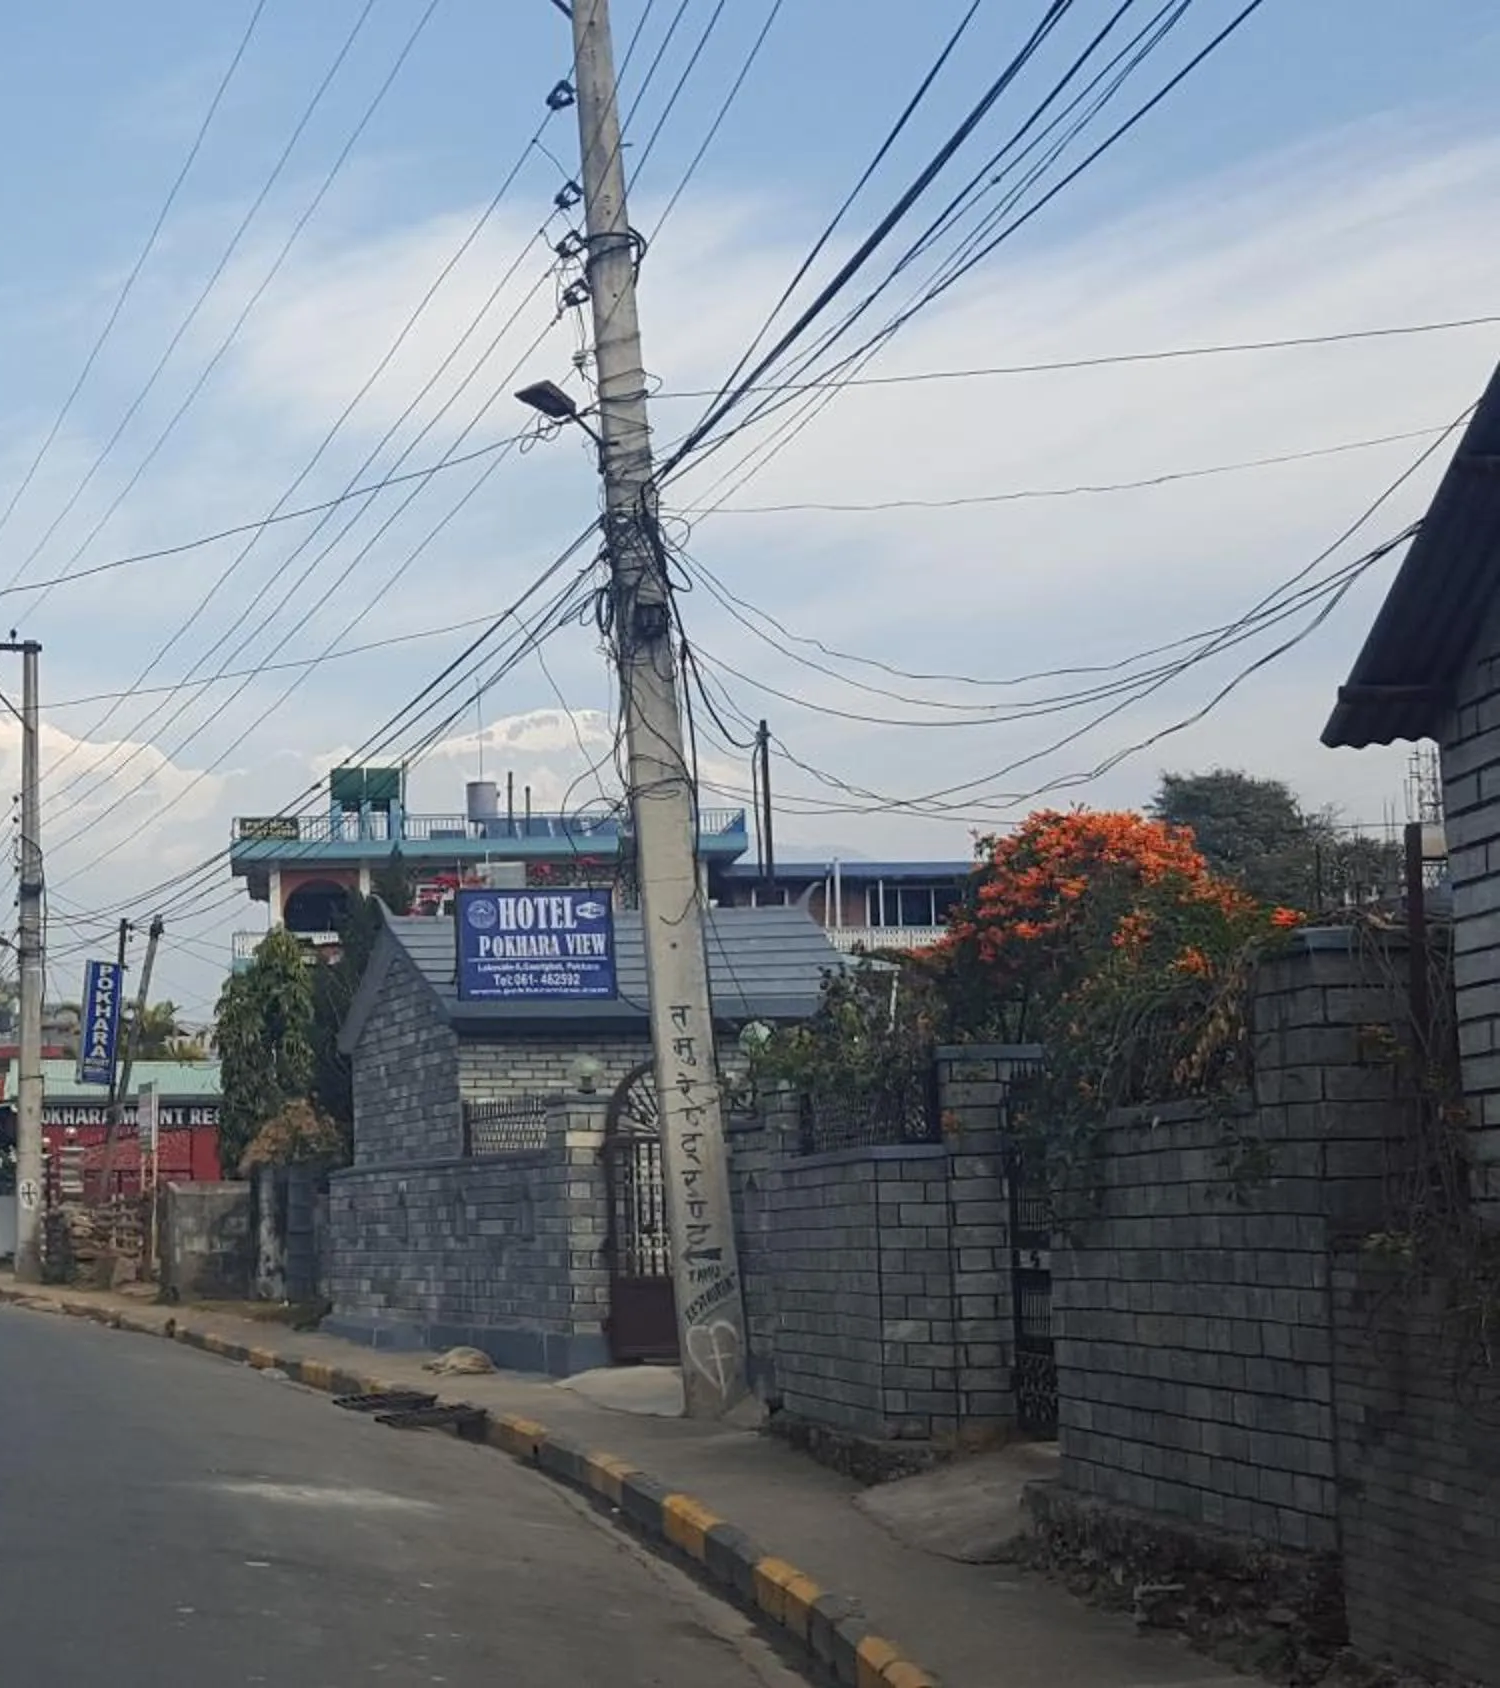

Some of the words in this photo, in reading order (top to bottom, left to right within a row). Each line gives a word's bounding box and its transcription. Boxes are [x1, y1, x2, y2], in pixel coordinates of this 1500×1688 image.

[498, 896, 577, 929] HOTEL
[479, 935, 560, 957] POKHARA
[565, 933, 606, 955] VIEW
[90, 964, 114, 1058] POKHARA
[40, 1107, 108, 1125] OKHAR
[119, 1107, 185, 1125] MNT
